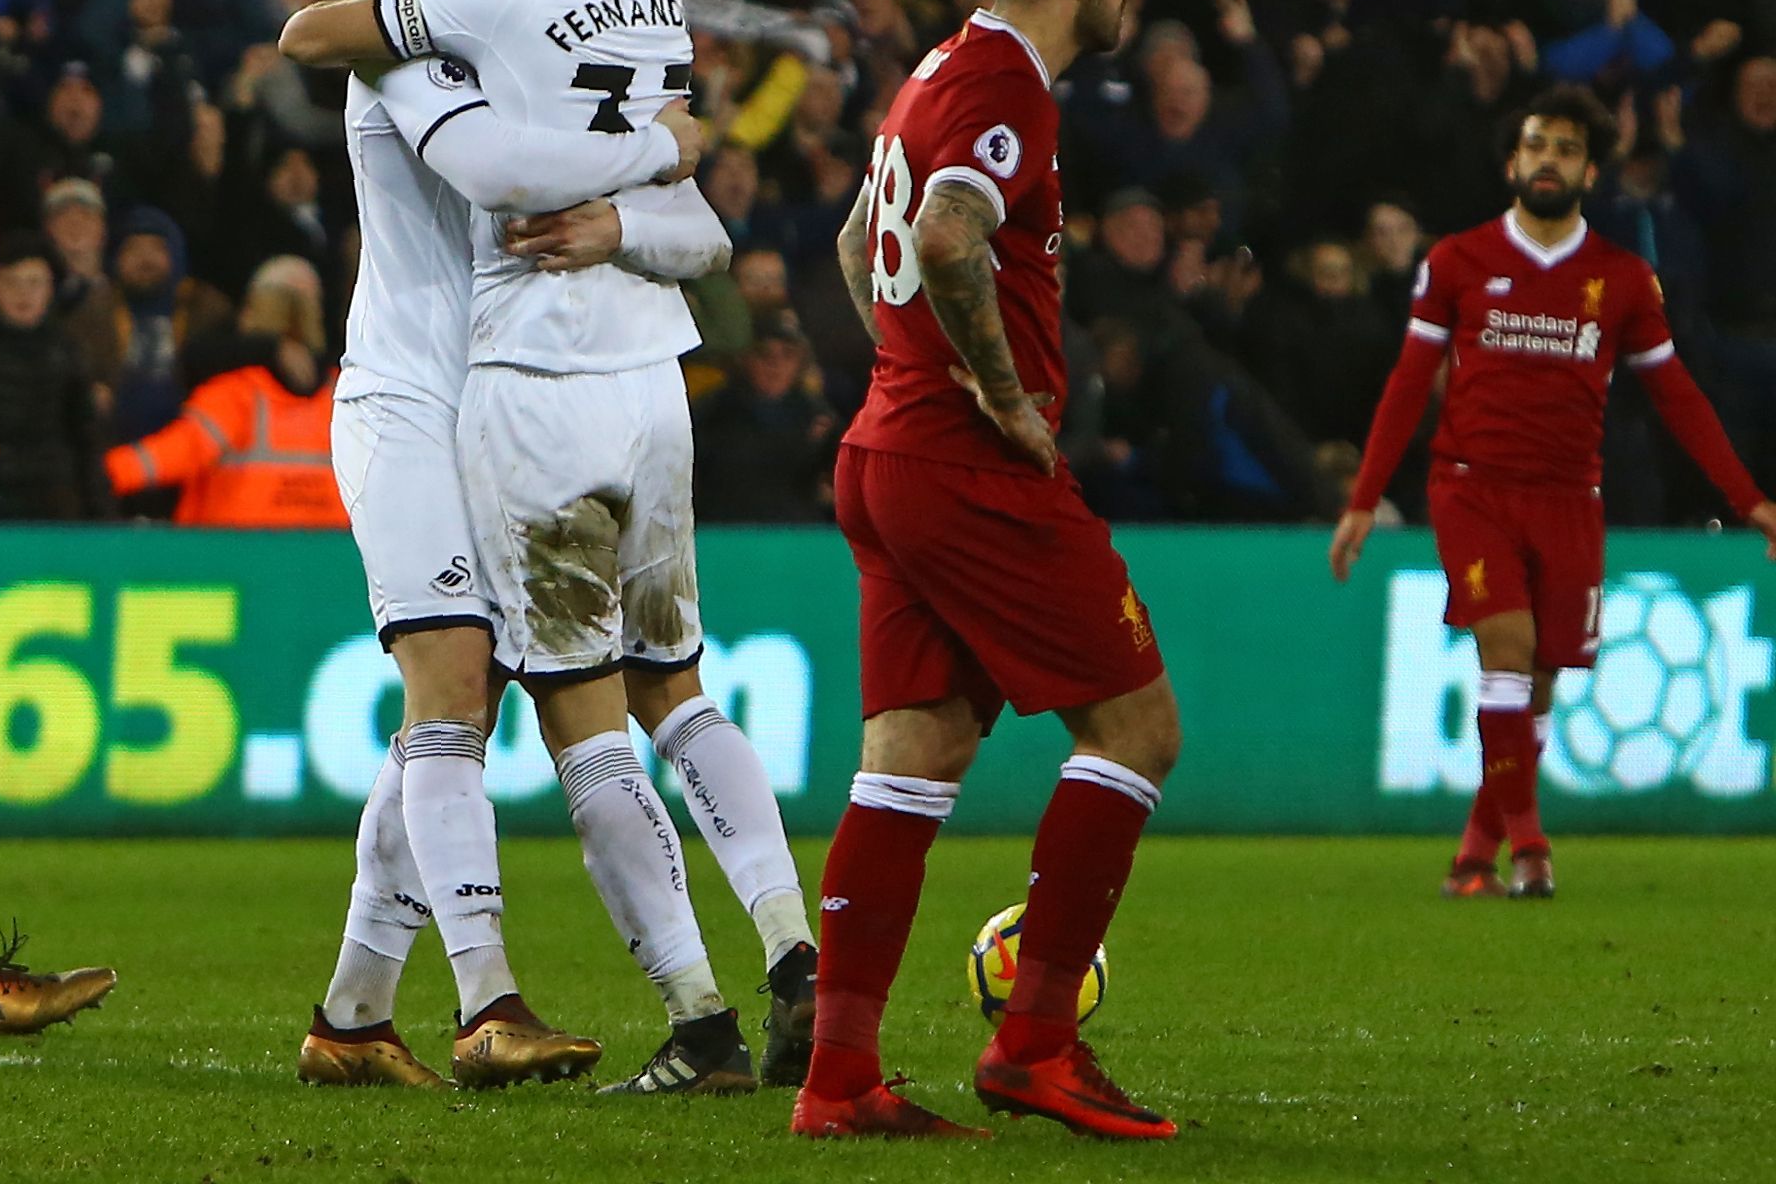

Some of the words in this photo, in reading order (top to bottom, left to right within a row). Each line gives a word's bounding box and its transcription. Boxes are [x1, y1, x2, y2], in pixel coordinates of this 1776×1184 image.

[865, 134, 922, 306] 8
[1486, 307, 1577, 334] Standard
[1480, 327, 1574, 354] Chartered
[394, 892, 432, 917] JO
